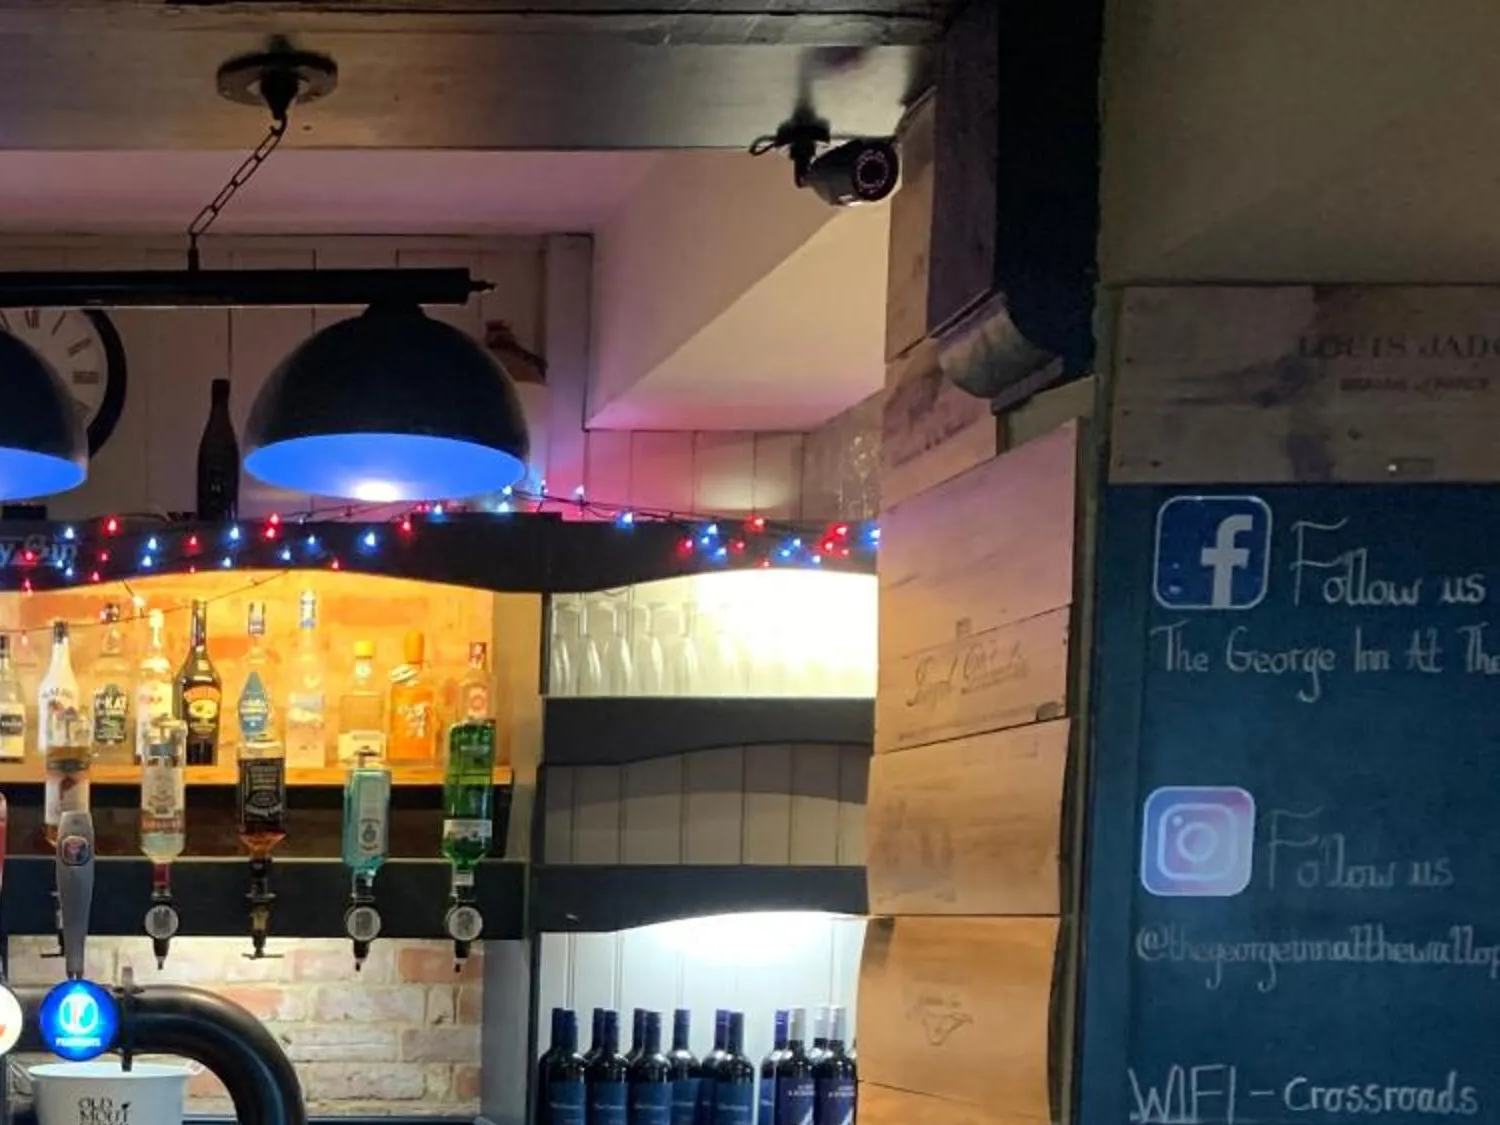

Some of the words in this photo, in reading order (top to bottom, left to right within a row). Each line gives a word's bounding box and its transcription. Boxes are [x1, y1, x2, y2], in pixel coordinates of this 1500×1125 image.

[1419, 333, 1500, 358] JAD
[1290, 515, 1421, 607] Follow
[1442, 573, 1487, 605] us
[1150, 618, 1209, 673] The
[1226, 626, 1336, 703] George
[1355, 627, 1390, 673] Inn
[1263, 805, 1398, 889] Follow
[1409, 856, 1455, 888] us
[78, 1097, 114, 1111] OLD
[1128, 1063, 1237, 1125] WIFI
[1284, 1070, 1479, 1114] Crossroads
